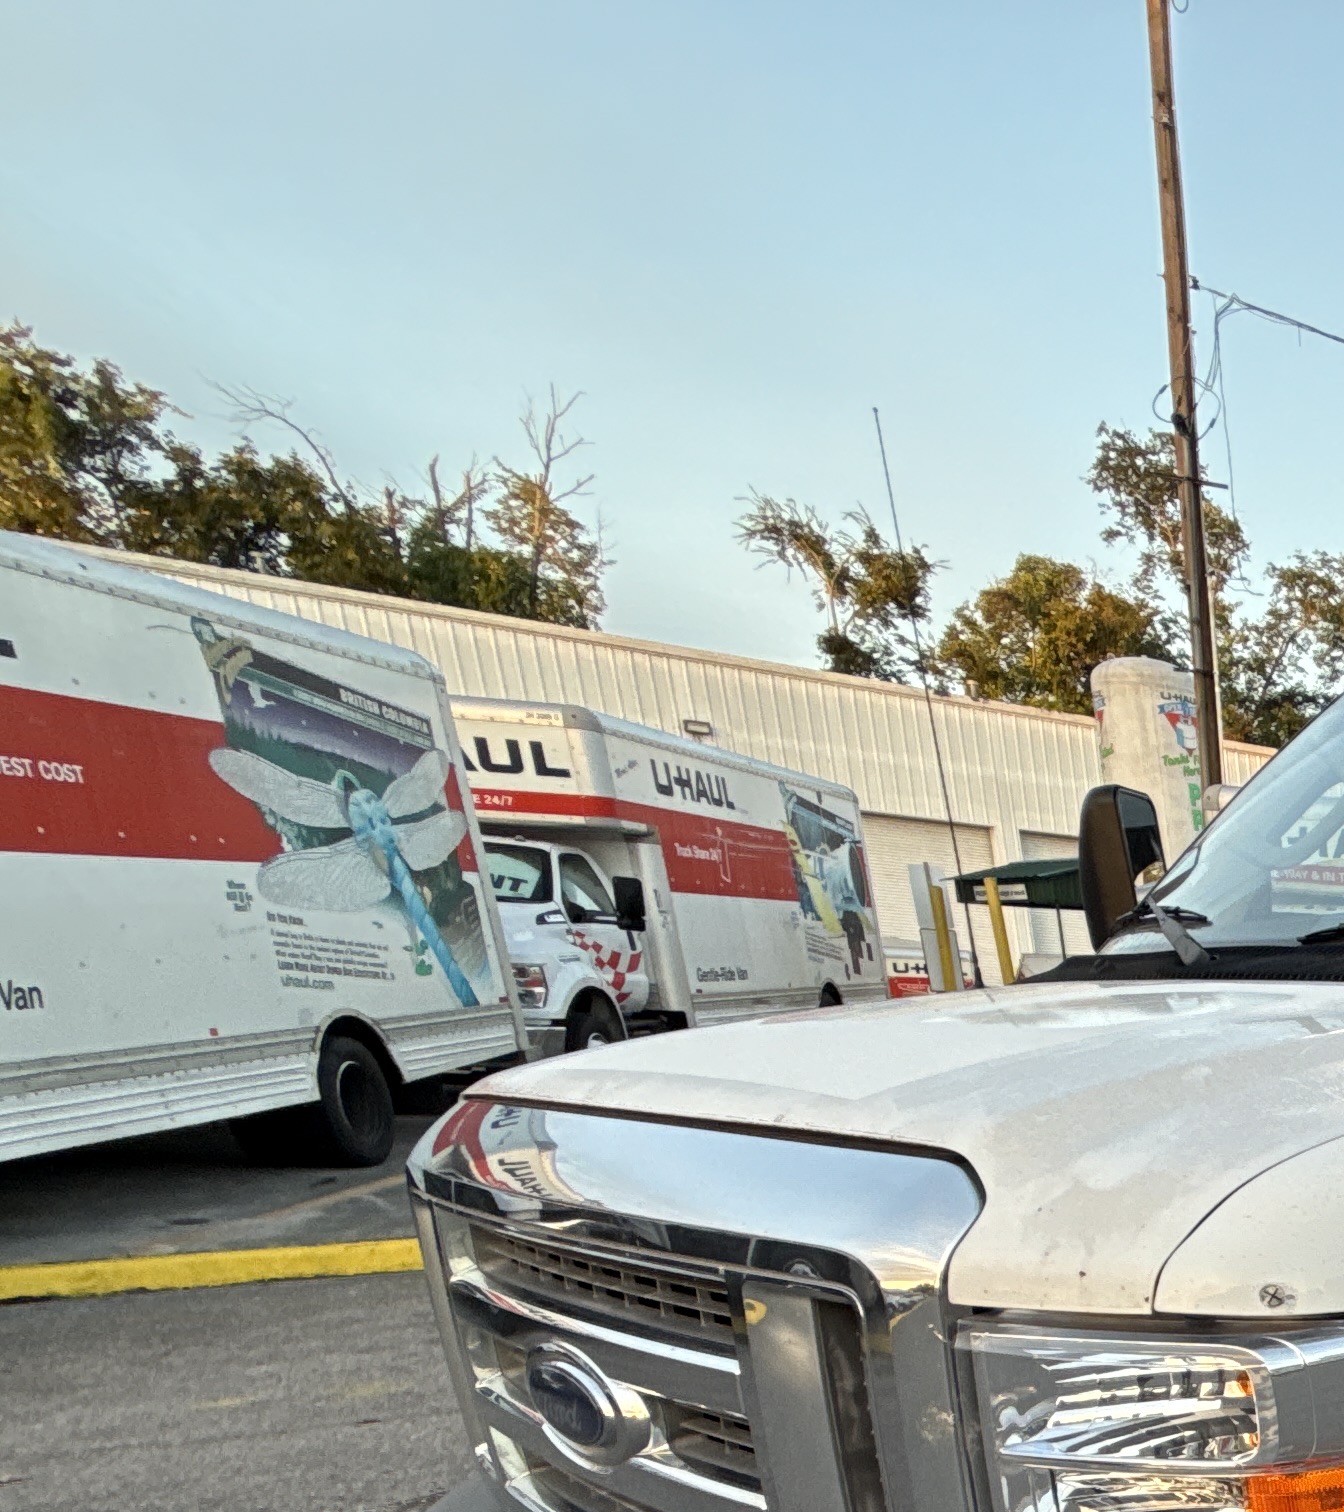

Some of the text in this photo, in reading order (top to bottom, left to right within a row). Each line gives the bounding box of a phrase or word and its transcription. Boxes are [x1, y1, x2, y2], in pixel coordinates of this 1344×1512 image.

[0, 755, 85, 784] EST COST
[650, 758, 736, 810] U-HAUL
[484, 795, 513, 806] 24/7
